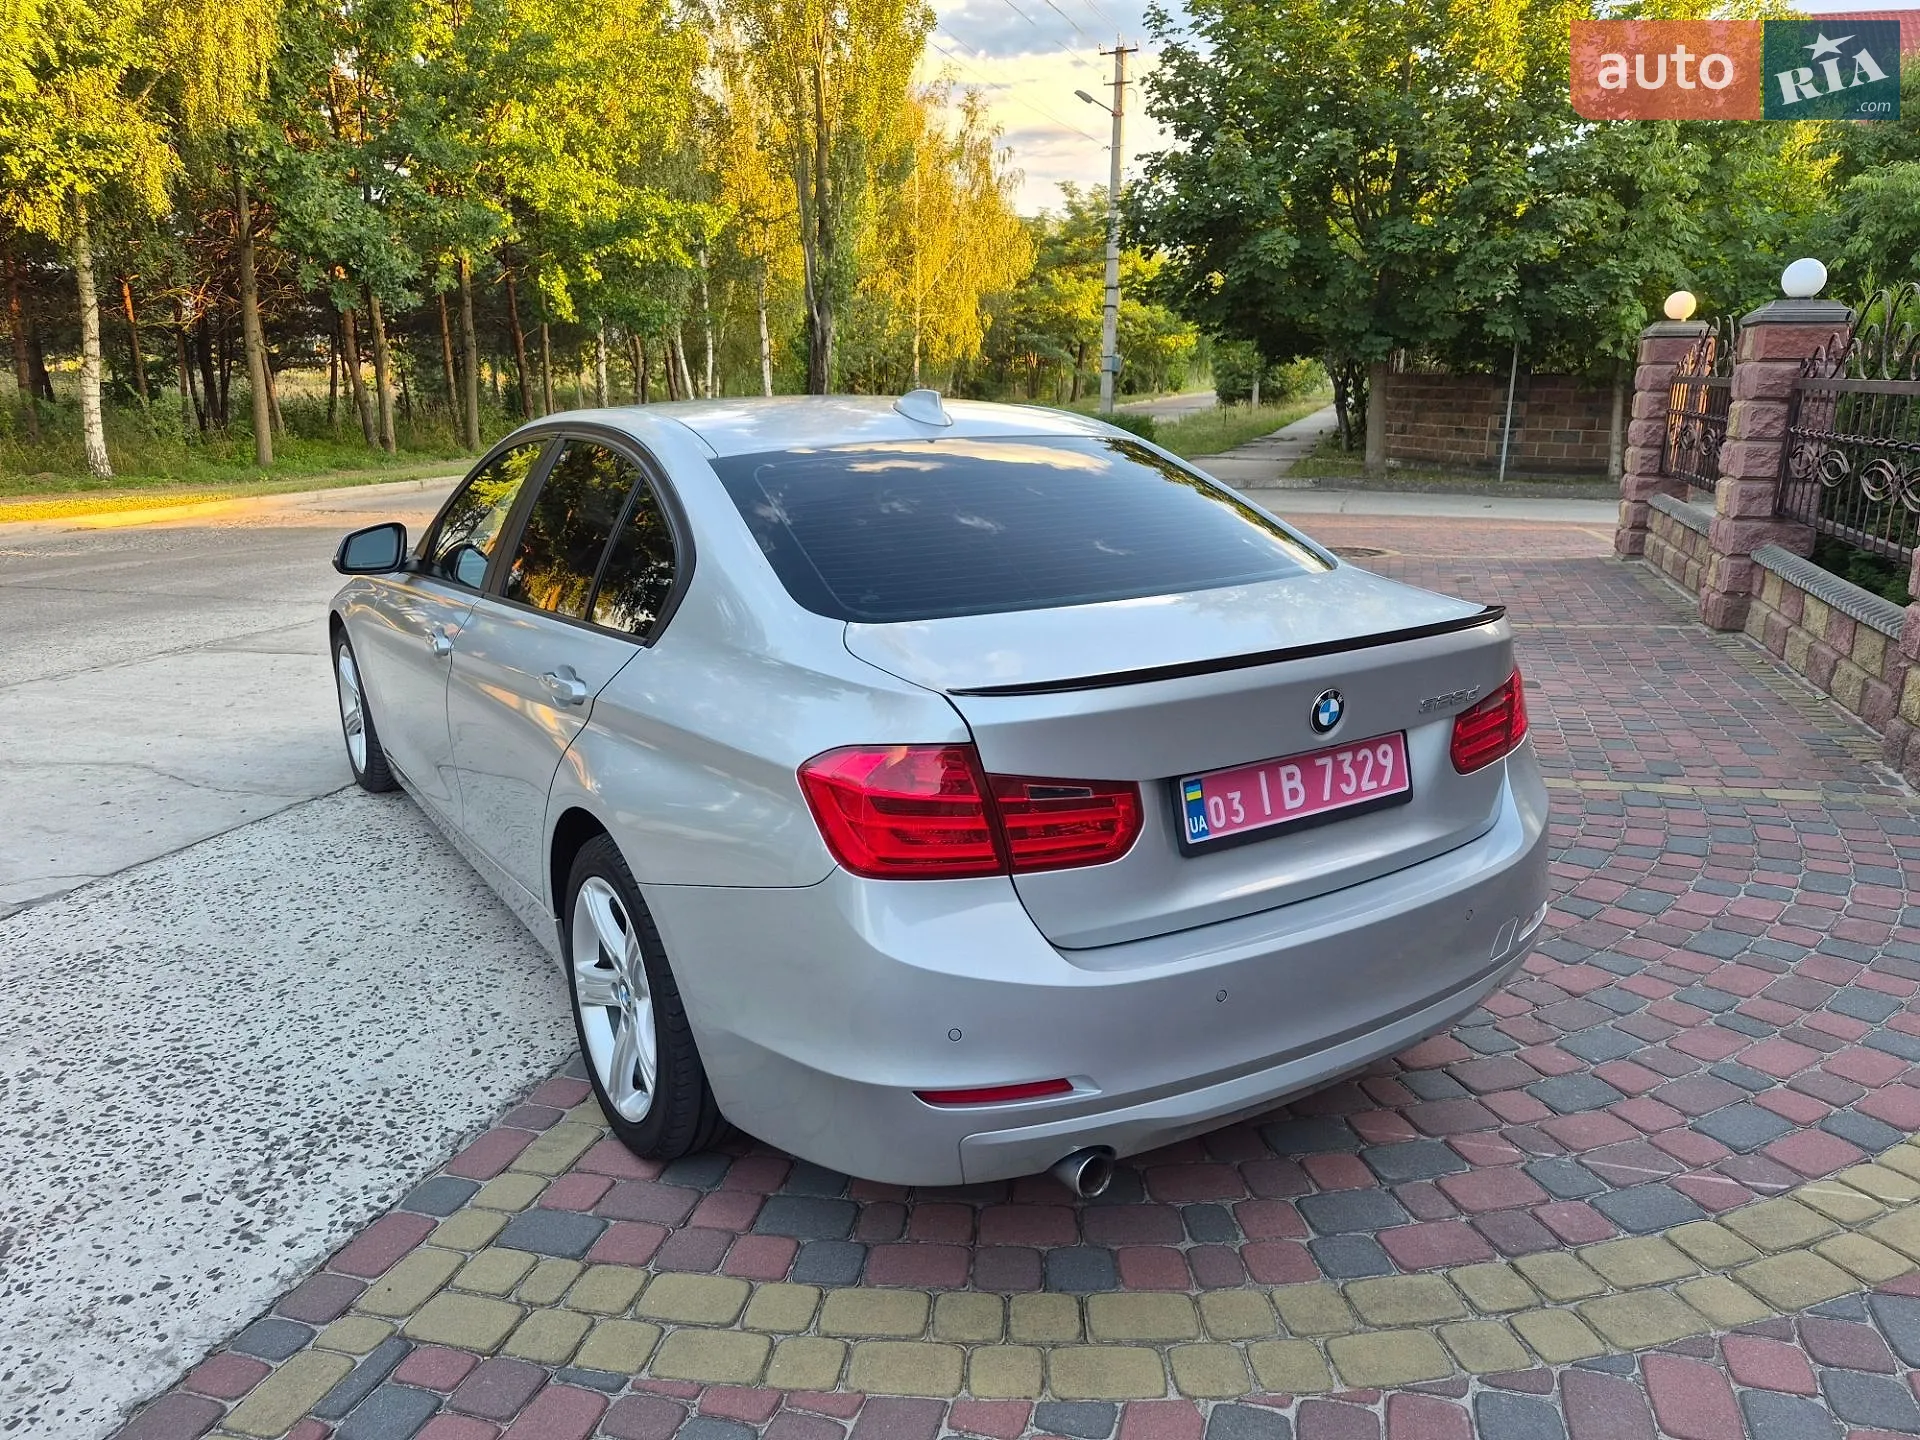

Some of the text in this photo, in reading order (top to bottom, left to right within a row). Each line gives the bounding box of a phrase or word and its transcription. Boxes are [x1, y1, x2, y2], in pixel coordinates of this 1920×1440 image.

[1209, 744, 1394, 828] 03 IB 7329
[1189, 815, 1208, 834] UA
